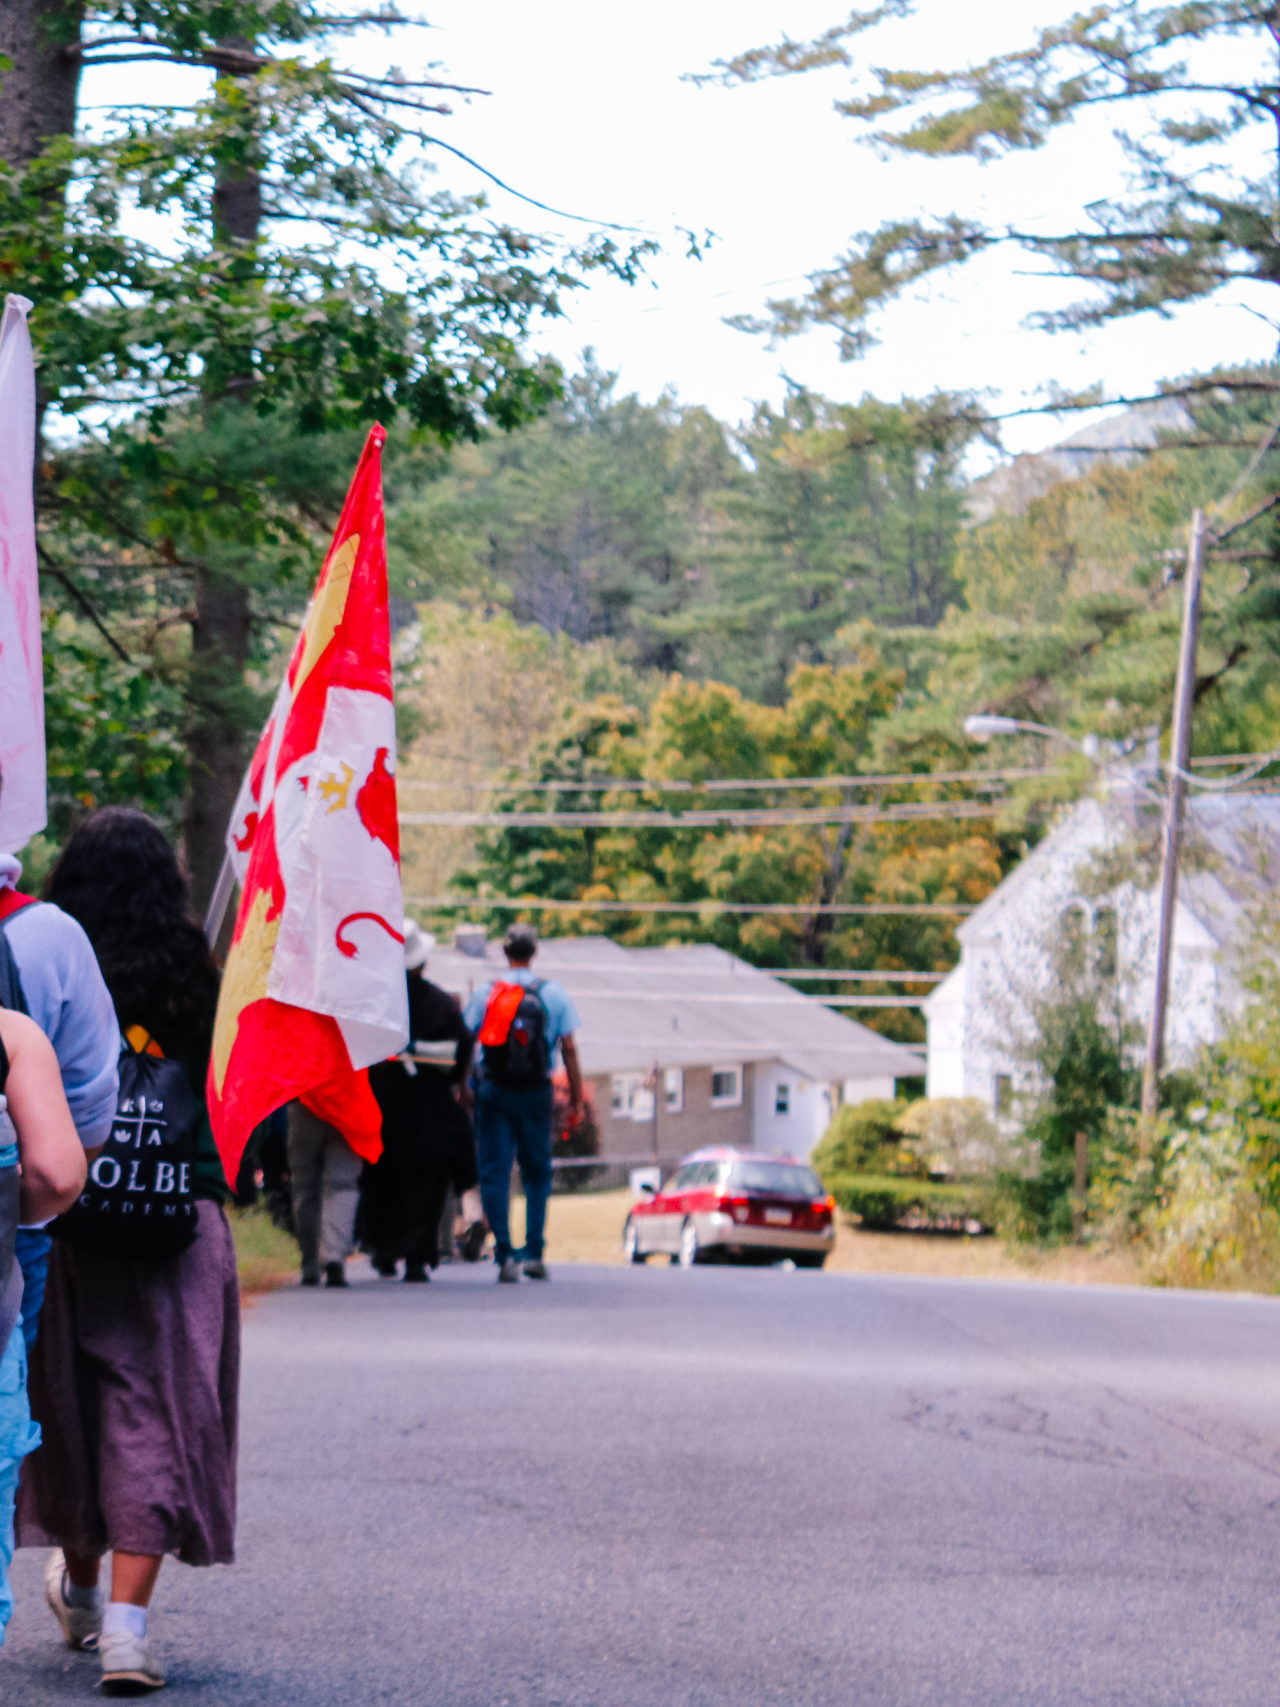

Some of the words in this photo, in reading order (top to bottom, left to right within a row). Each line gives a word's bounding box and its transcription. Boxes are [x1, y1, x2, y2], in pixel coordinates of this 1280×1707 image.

[147, 1128, 162, 1146] A
[90, 1156, 190, 1194] OLBE
[79, 1194, 192, 1216] CADEMY
